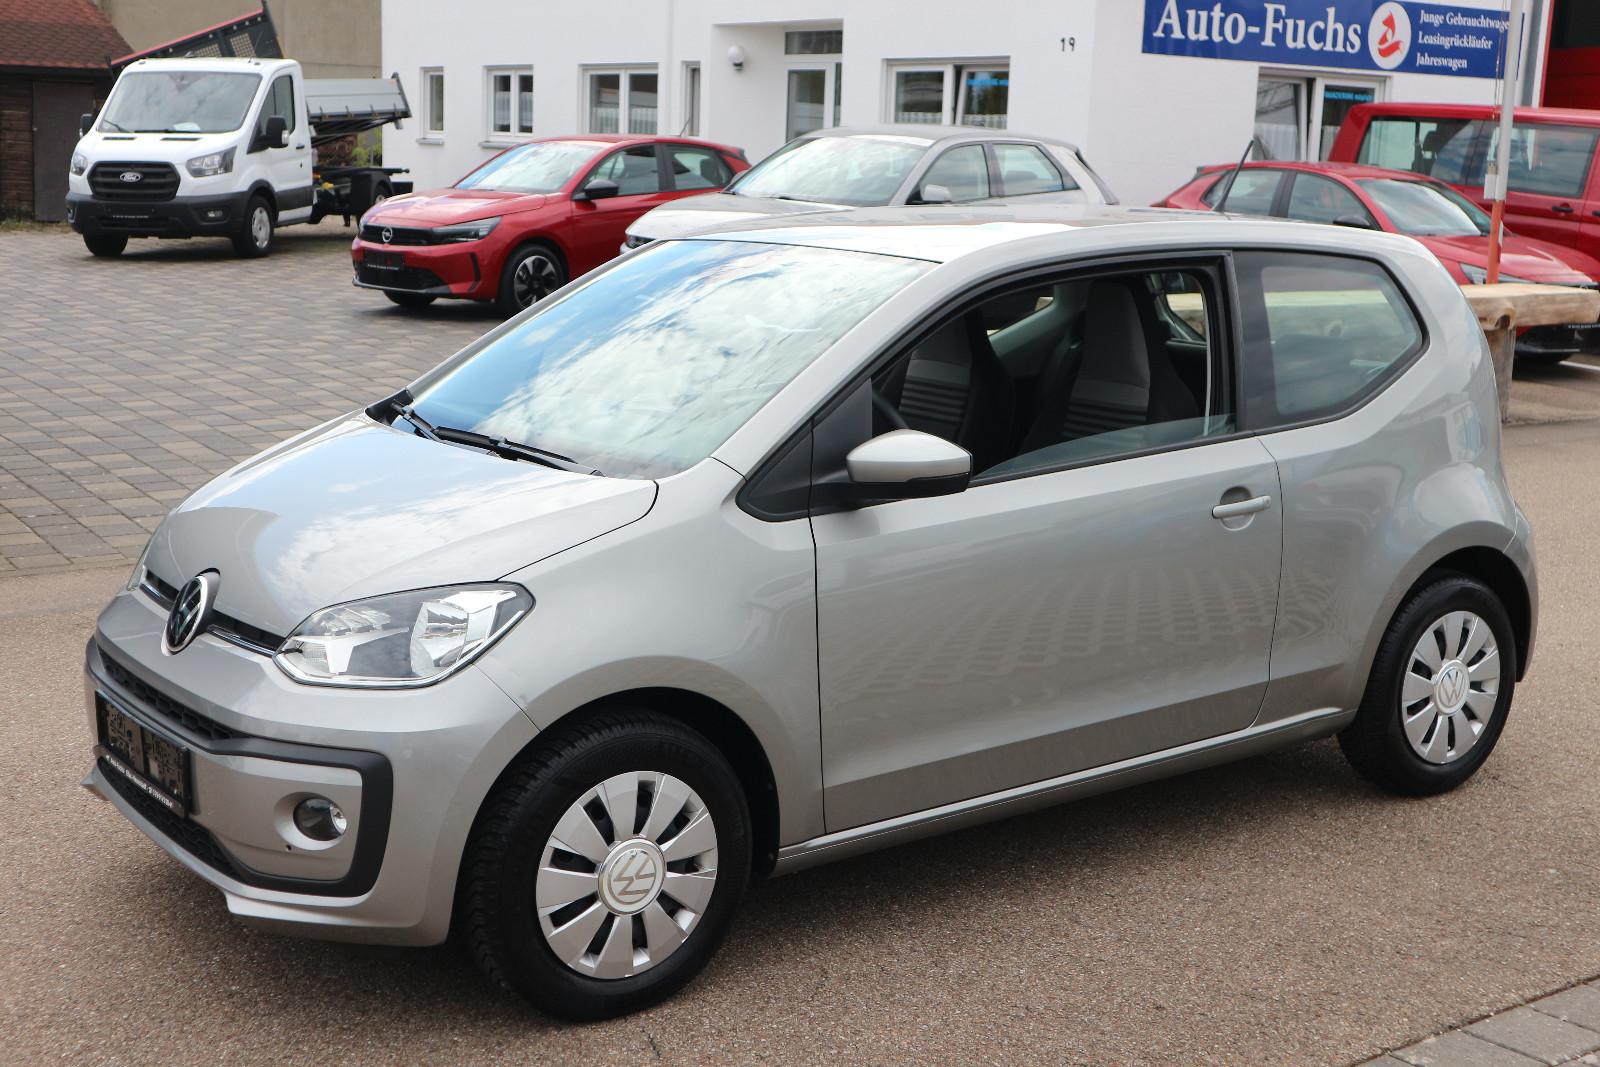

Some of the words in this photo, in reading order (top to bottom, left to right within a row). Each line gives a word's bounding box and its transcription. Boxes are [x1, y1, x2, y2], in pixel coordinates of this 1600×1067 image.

[1152, 0, 1361, 54] Auto-Fuchs
[1420, 9, 1444, 27] Junge
[1446, 12, 1509, 33] Gebrauchtwage
[1060, 37, 1075, 52] 19
[1418, 31, 1493, 49] Leasingrückläufer
[1416, 52, 1468, 71] Jahreswagen
